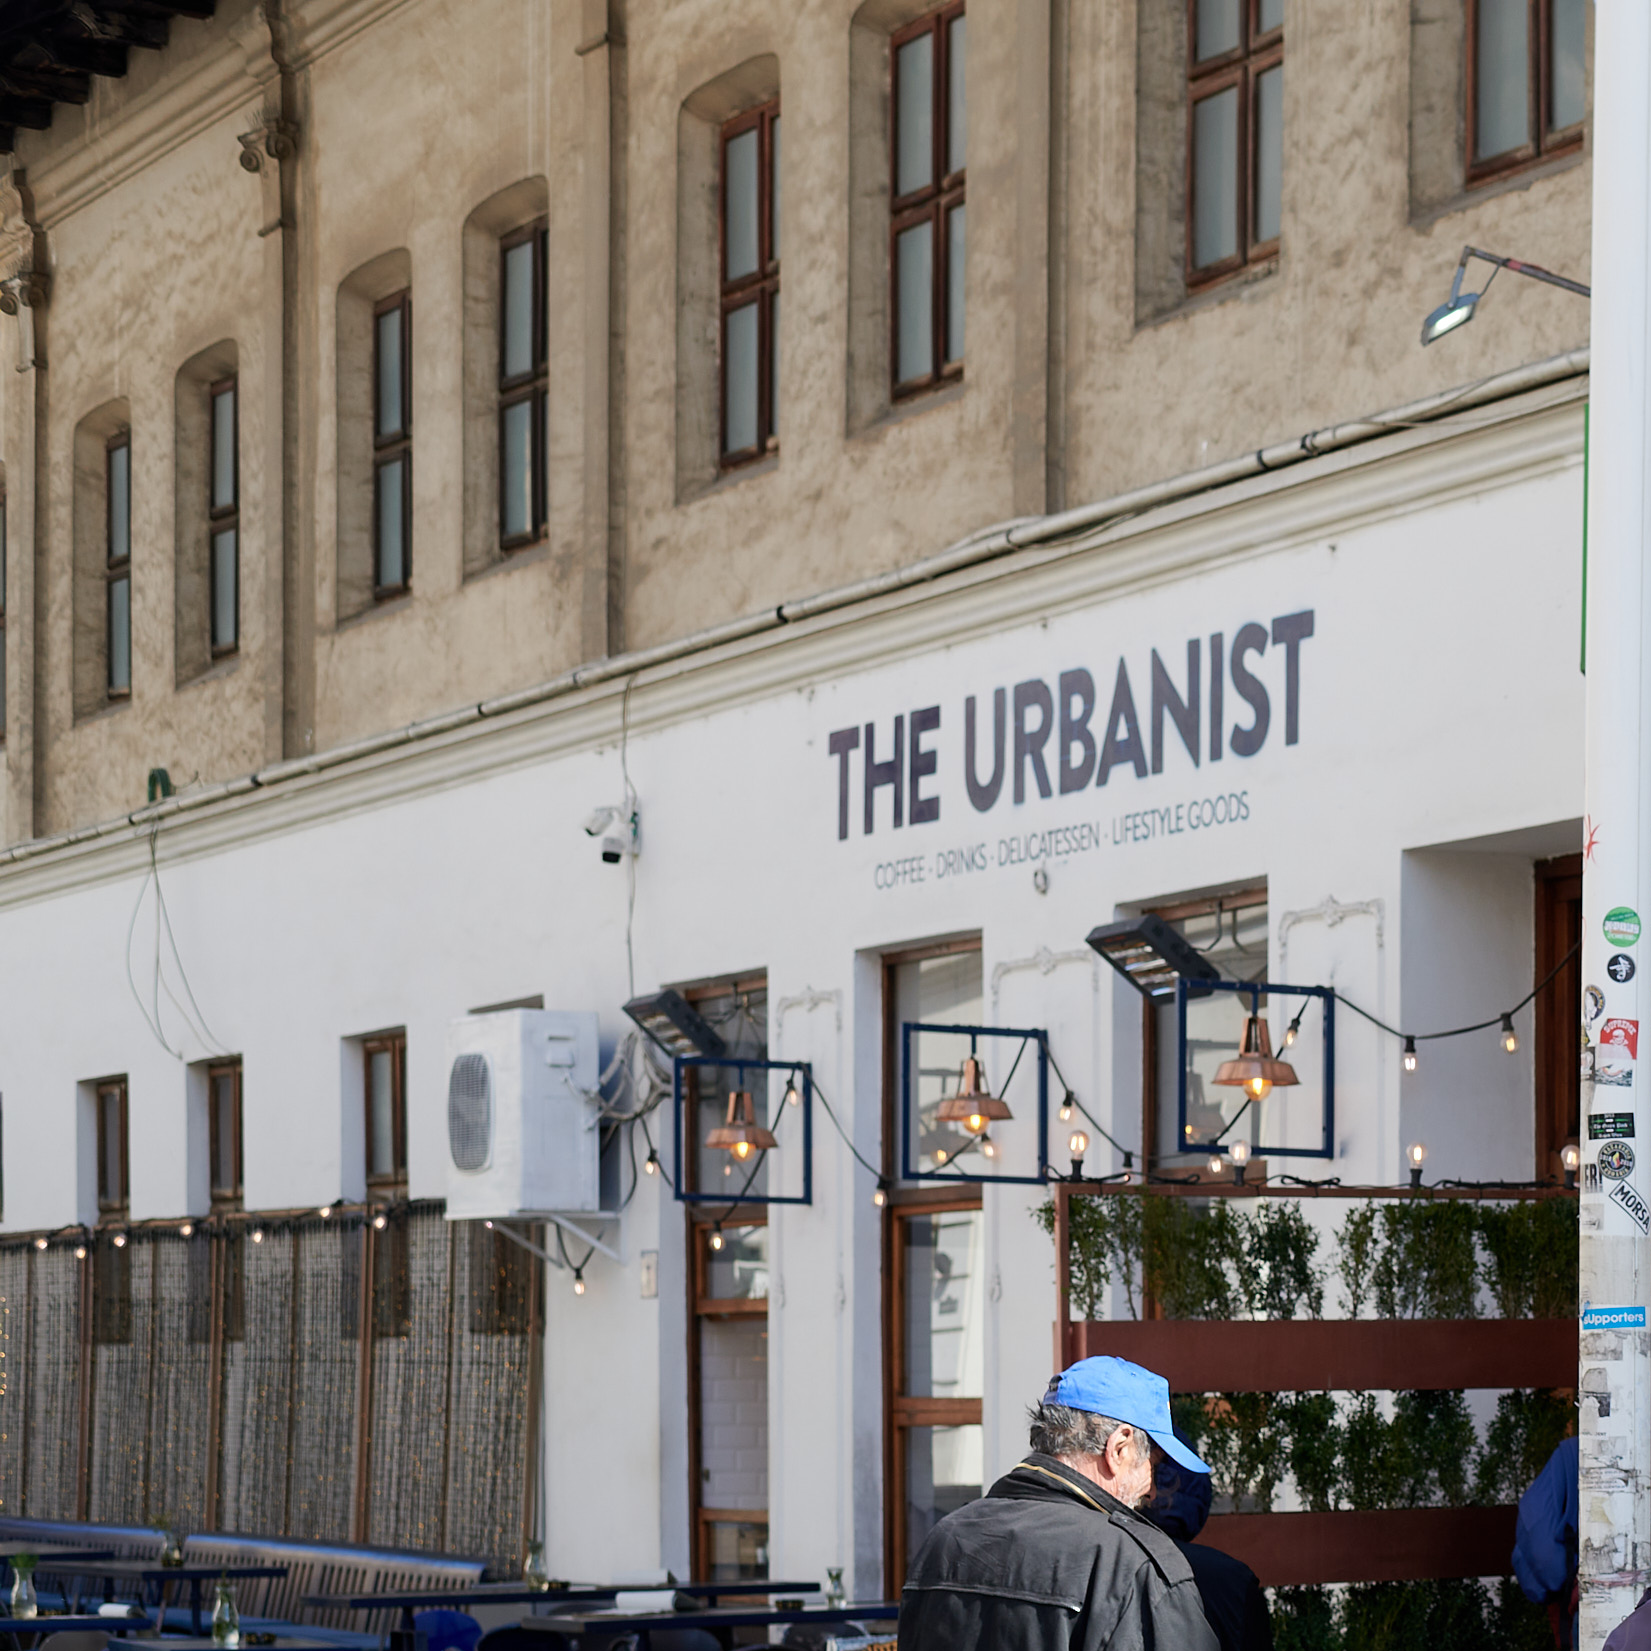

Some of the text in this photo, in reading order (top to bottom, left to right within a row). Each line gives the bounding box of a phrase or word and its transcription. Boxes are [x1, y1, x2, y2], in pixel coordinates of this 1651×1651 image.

[829, 609, 1315, 841] THE URBANIST
[874, 791, 1250, 889] COFFEE DRINKS DELICATESSEN LIFESTYLE GOODS
[1614, 1184, 1651, 1230] MORSA
